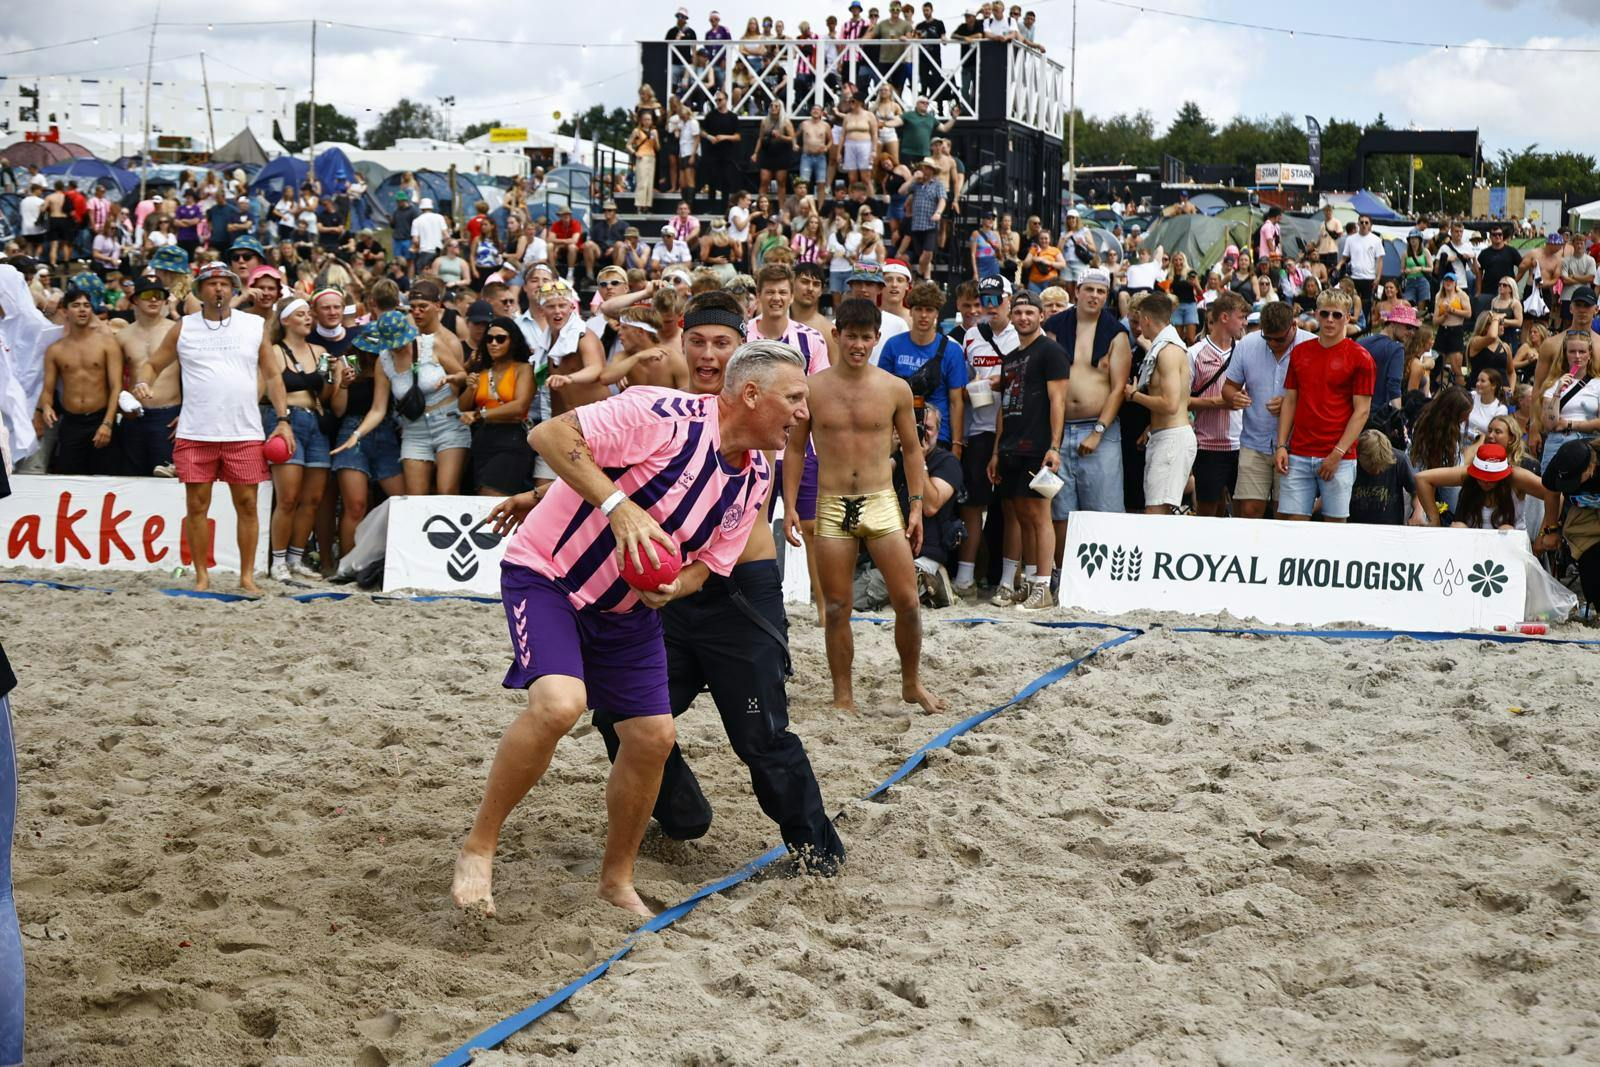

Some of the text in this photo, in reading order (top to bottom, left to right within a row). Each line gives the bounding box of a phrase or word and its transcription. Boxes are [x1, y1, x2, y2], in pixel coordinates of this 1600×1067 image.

[1262, 167, 1279, 178] STARK
[1290, 168, 1313, 179] STARK
[1152, 551, 1425, 592] ROYAL ØKOLOGISK
